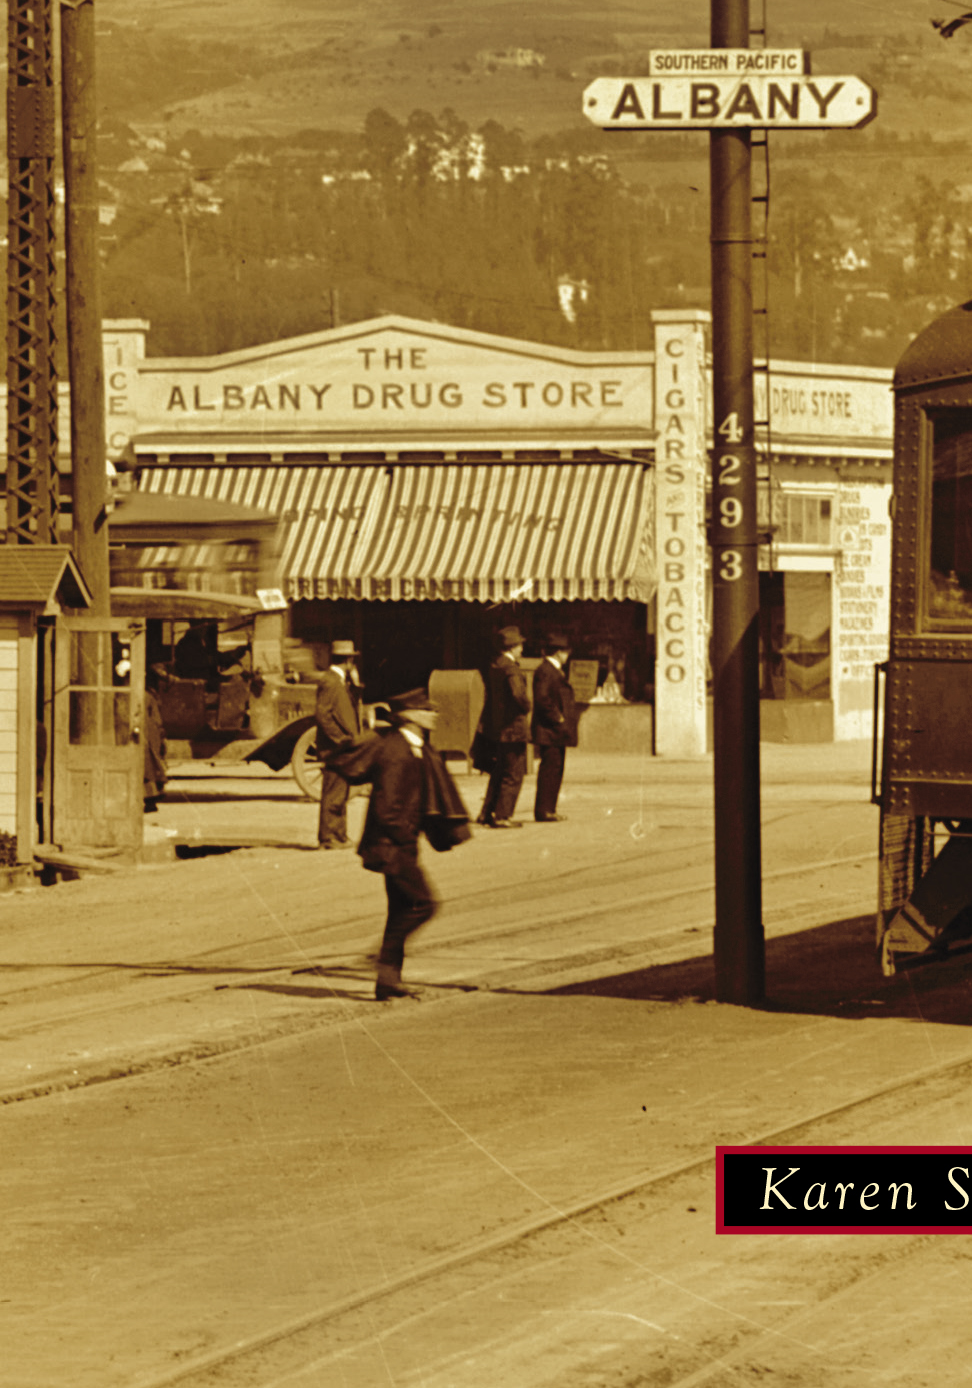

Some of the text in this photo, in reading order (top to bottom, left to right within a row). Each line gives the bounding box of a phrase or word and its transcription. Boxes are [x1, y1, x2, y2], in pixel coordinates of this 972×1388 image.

[655, 55, 797, 70] SOUTHERN PACIFIC
[611, 83, 845, 120] ALBANY
[358, 348, 427, 370] THE
[166, 381, 623, 411] ALBANY DRUG STORE
[665, 338, 685, 484] CIGARS
[772, 387, 806, 416] DRUG
[812, 390, 852, 418] STORE
[665, 512, 686, 685] TOBACCO
